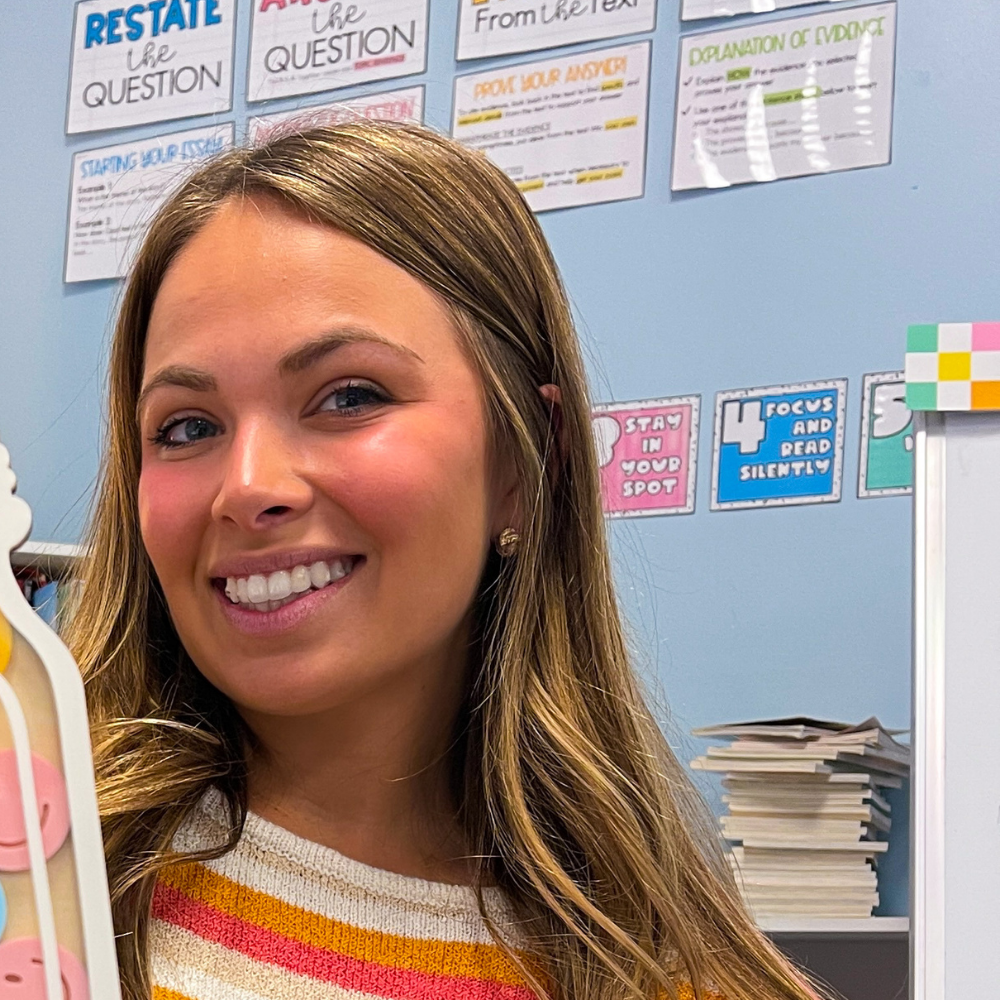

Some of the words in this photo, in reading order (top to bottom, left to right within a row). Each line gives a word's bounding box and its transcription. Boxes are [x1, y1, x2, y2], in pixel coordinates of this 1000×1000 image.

[84, 0, 222, 48] RESTATE
[311, 1, 367, 34] the
[475, 8, 535, 33] From
[541, 0, 588, 24] the
[126, 42, 177, 72] the
[264, 20, 416, 73] QUESTION
[689, 31, 786, 67] EXPLANATION
[789, 28, 811, 50] OF
[815, 17, 887, 48] EVIDENCE
[82, 61, 222, 109] QUESTION
[474, 76, 515, 100] PROVE
[521, 68, 560, 92] YOUR
[80, 154, 137, 180] STARTING
[140, 144, 179, 168] YOUR
[625, 414, 683, 433] STAY
[766, 397, 834, 420] FOCUS
[722, 400, 767, 455] 4
[793, 418, 833, 437] AND
[642, 437, 662, 454] IN
[780, 438, 832, 458] READ
[621, 457, 682, 476] YOUR
[740, 459, 831, 481] SILENTLY
[623, 478, 678, 497] SPOT
